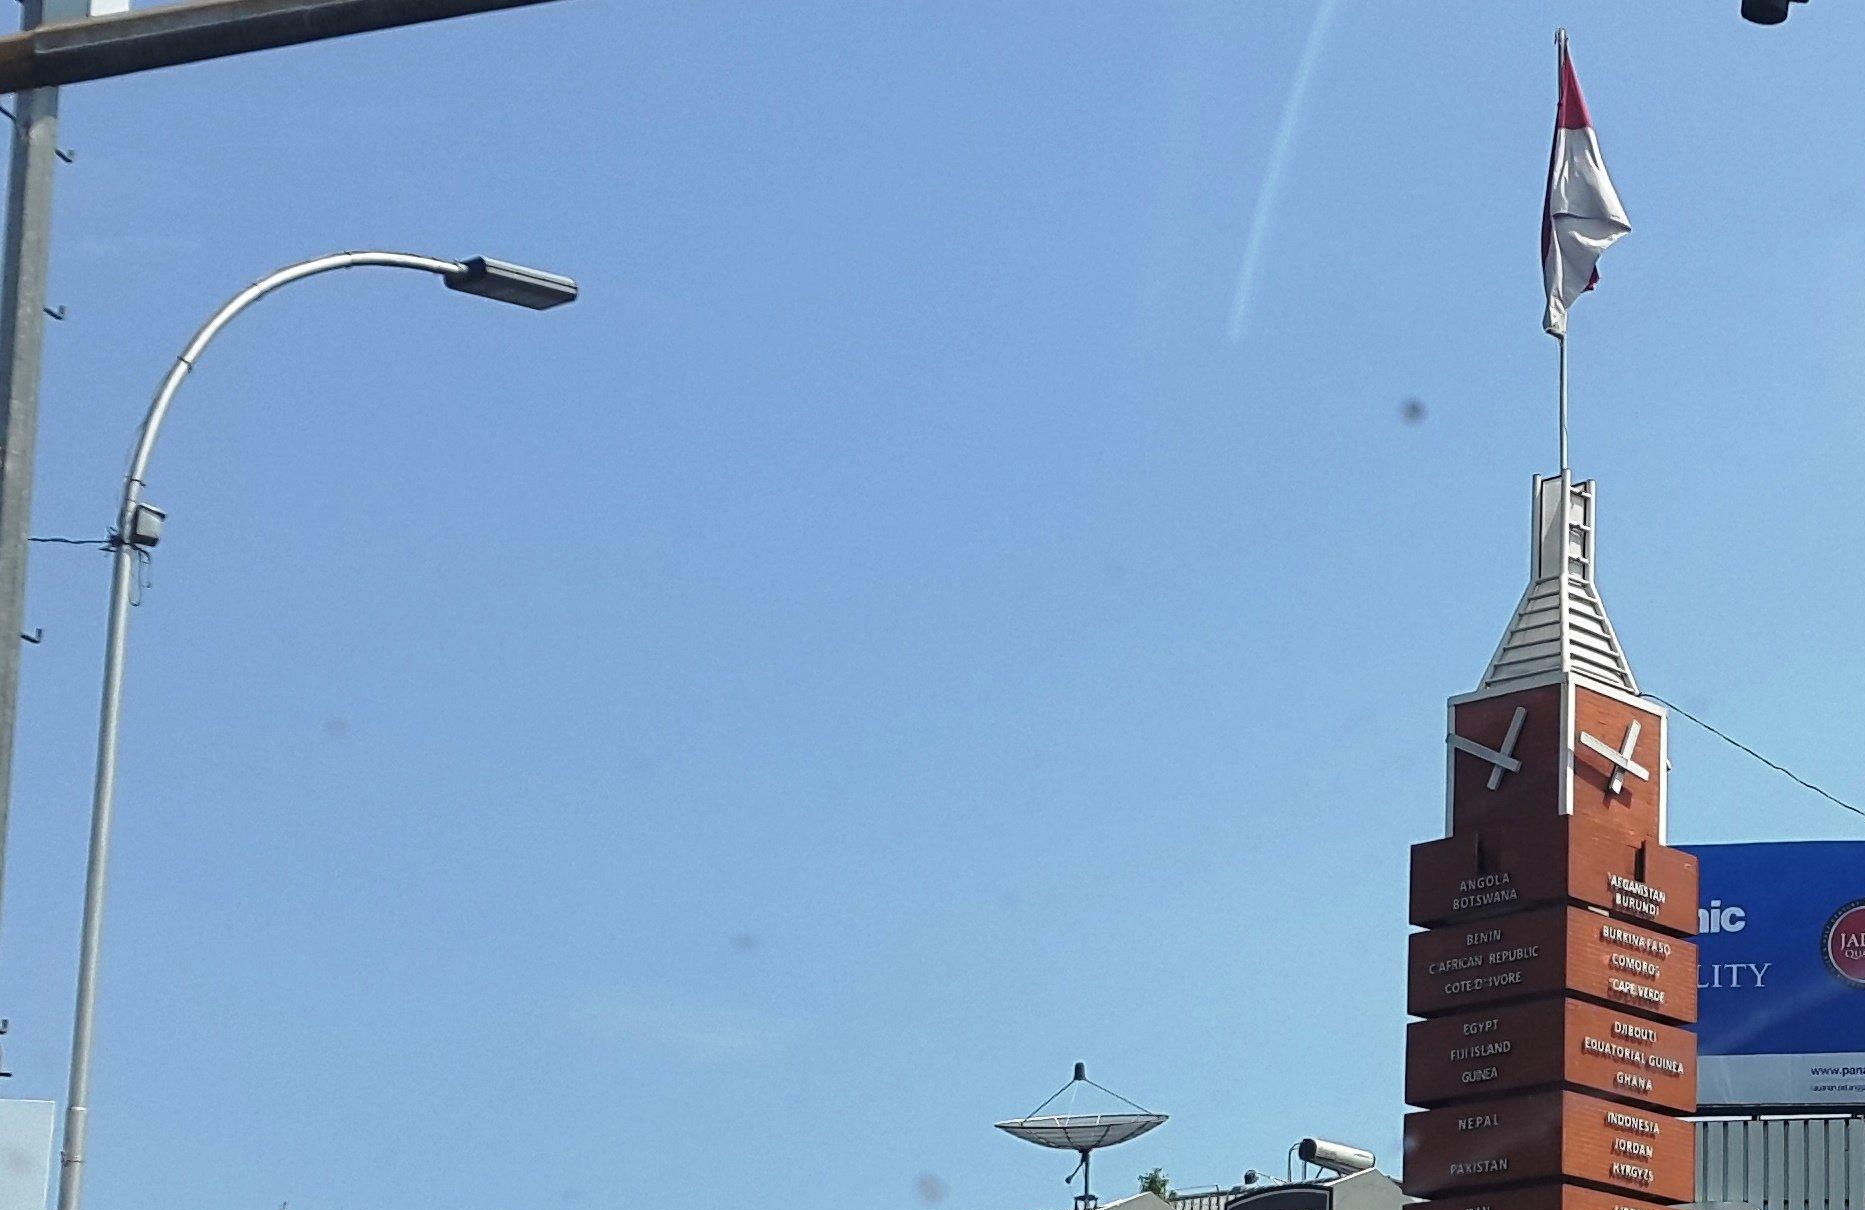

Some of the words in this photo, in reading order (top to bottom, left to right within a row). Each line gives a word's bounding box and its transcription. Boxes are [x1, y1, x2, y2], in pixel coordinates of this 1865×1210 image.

[1459, 873, 1511, 892] ANGOLA
[1452, 889, 1518, 910] BOTSWANA
[1615, 892, 1660, 915] BURUNDI
[1466, 929, 1502, 946] BENIN
[1602, 925, 1645, 950] BURKINA
[1489, 945, 1539, 965] REPUBLIC
[1611, 953, 1660, 978] COMOROS
[1612, 979, 1638, 995] CAPE
[1638, 985, 1665, 1004] VERDE
[1463, 1019, 1499, 1036] EGYPT
[1614, 1021, 1657, 1043] DJIBOUTI
[1450, 1047, 1468, 1062] FIJI
[1469, 1040, 1511, 1058] ISLAND
[1584, 1036, 1646, 1065] EQUATORIAL
[1648, 1055, 1685, 1075] GUINEA
[1461, 1066, 1498, 1083] GUINEA
[1616, 1071, 1653, 1091] GHANA
[1458, 1114, 1499, 1131] NEPAL
[1606, 1111, 1660, 1135] INDONESIA
[1615, 1138, 1654, 1158] JORDAN
[1450, 1158, 1509, 1176] PAKISTAN
